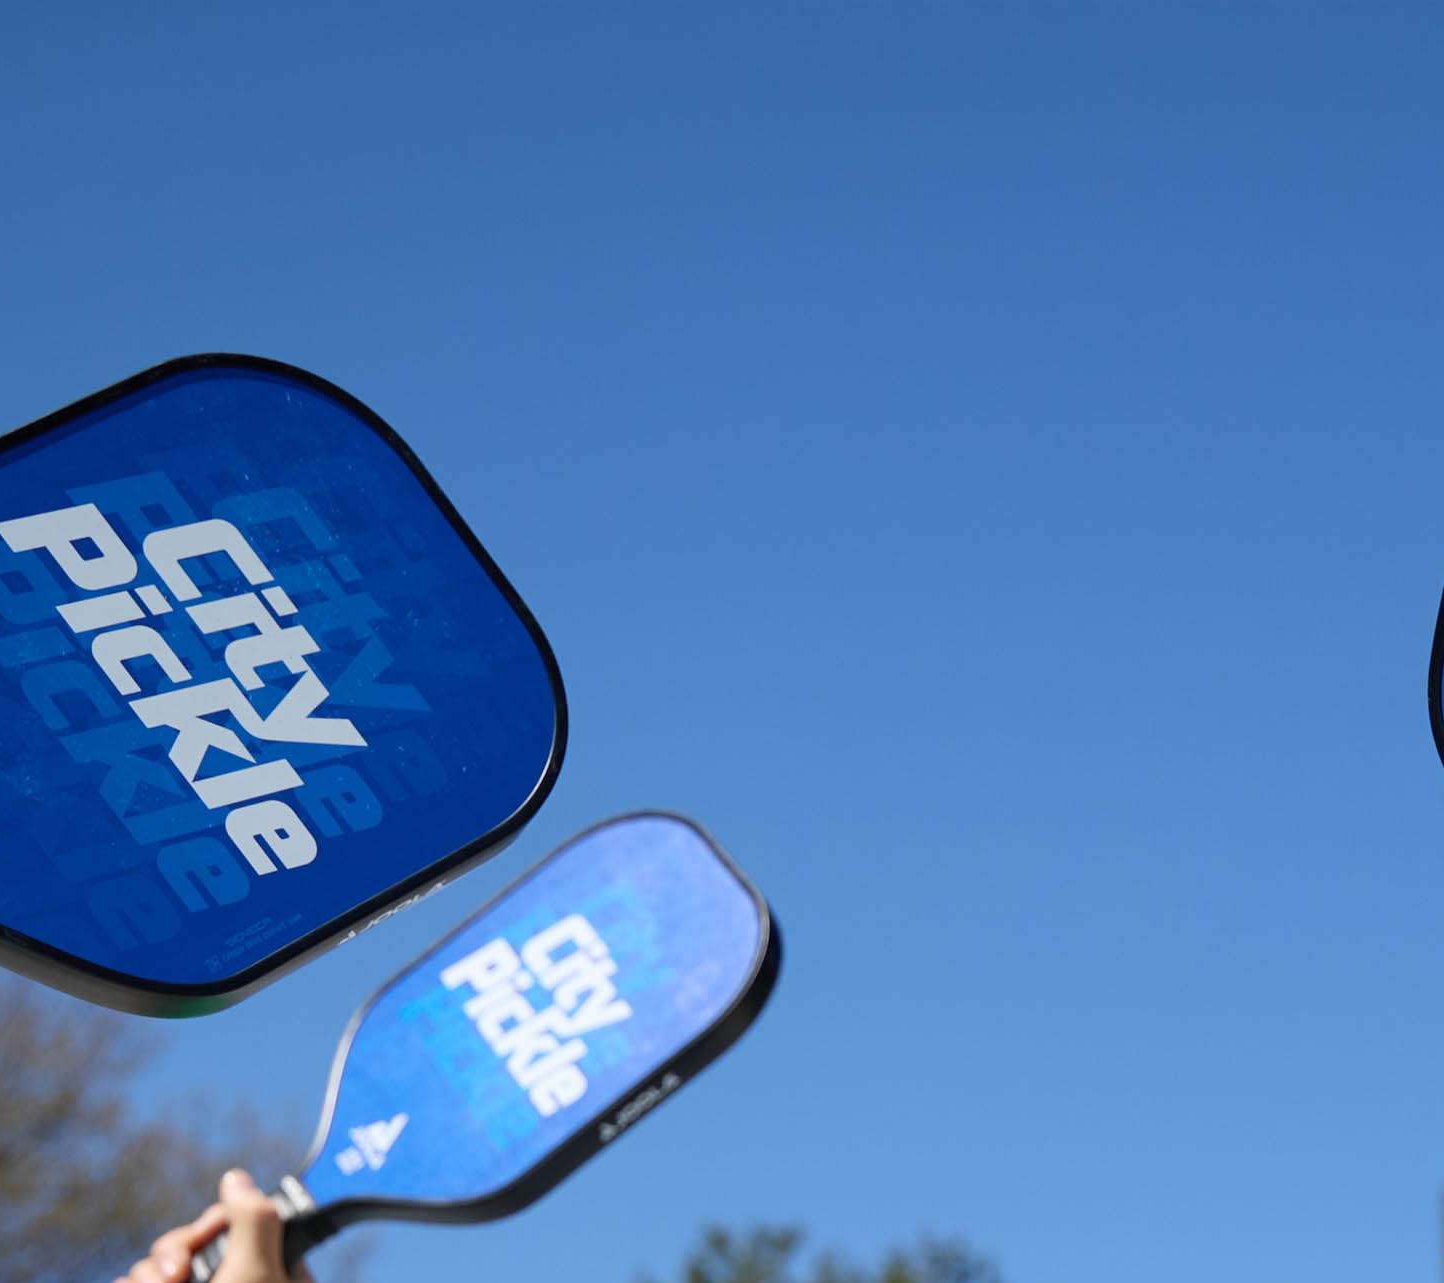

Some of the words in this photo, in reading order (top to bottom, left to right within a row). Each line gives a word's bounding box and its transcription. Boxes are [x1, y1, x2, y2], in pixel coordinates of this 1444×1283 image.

[142, 518, 368, 747] City
[440, 937, 588, 1117] Pickle
[520, 914, 632, 1042] City
